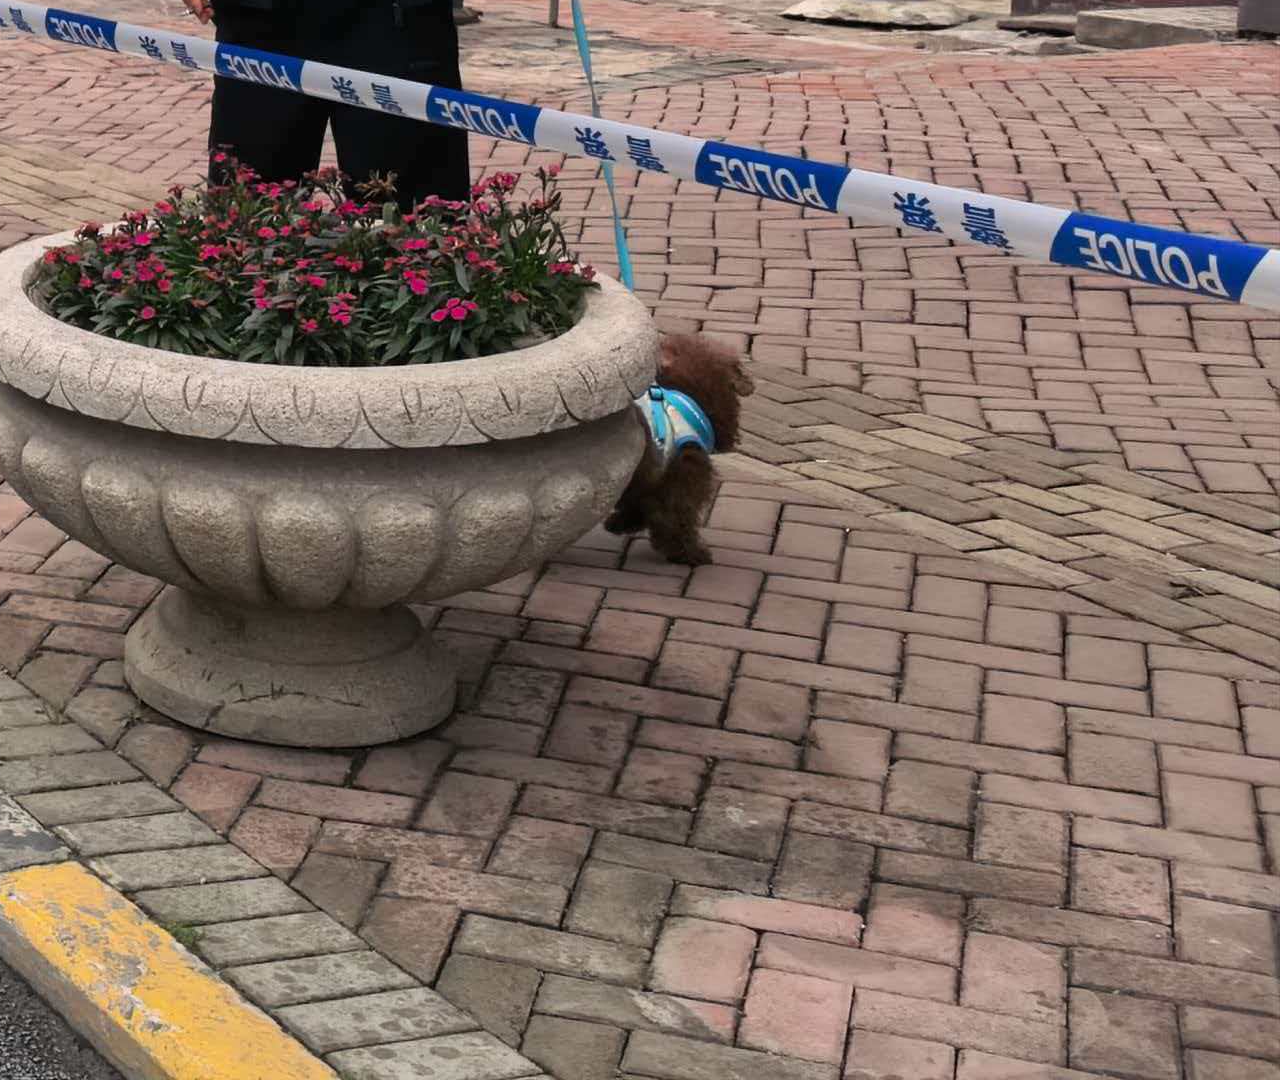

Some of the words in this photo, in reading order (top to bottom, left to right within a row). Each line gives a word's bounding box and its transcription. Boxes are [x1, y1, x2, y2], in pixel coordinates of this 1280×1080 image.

[49, 17, 114, 50] POLICE
[221, 52, 298, 91] POLICE
[331, 76, 406, 115] 警察
[434, 98, 528, 142] POLICE
[574, 126, 669, 173] 警察
[708, 154, 829, 208] POLICE
[893, 191, 1016, 252] 警察
[1074, 227, 1230, 297] POLICE
